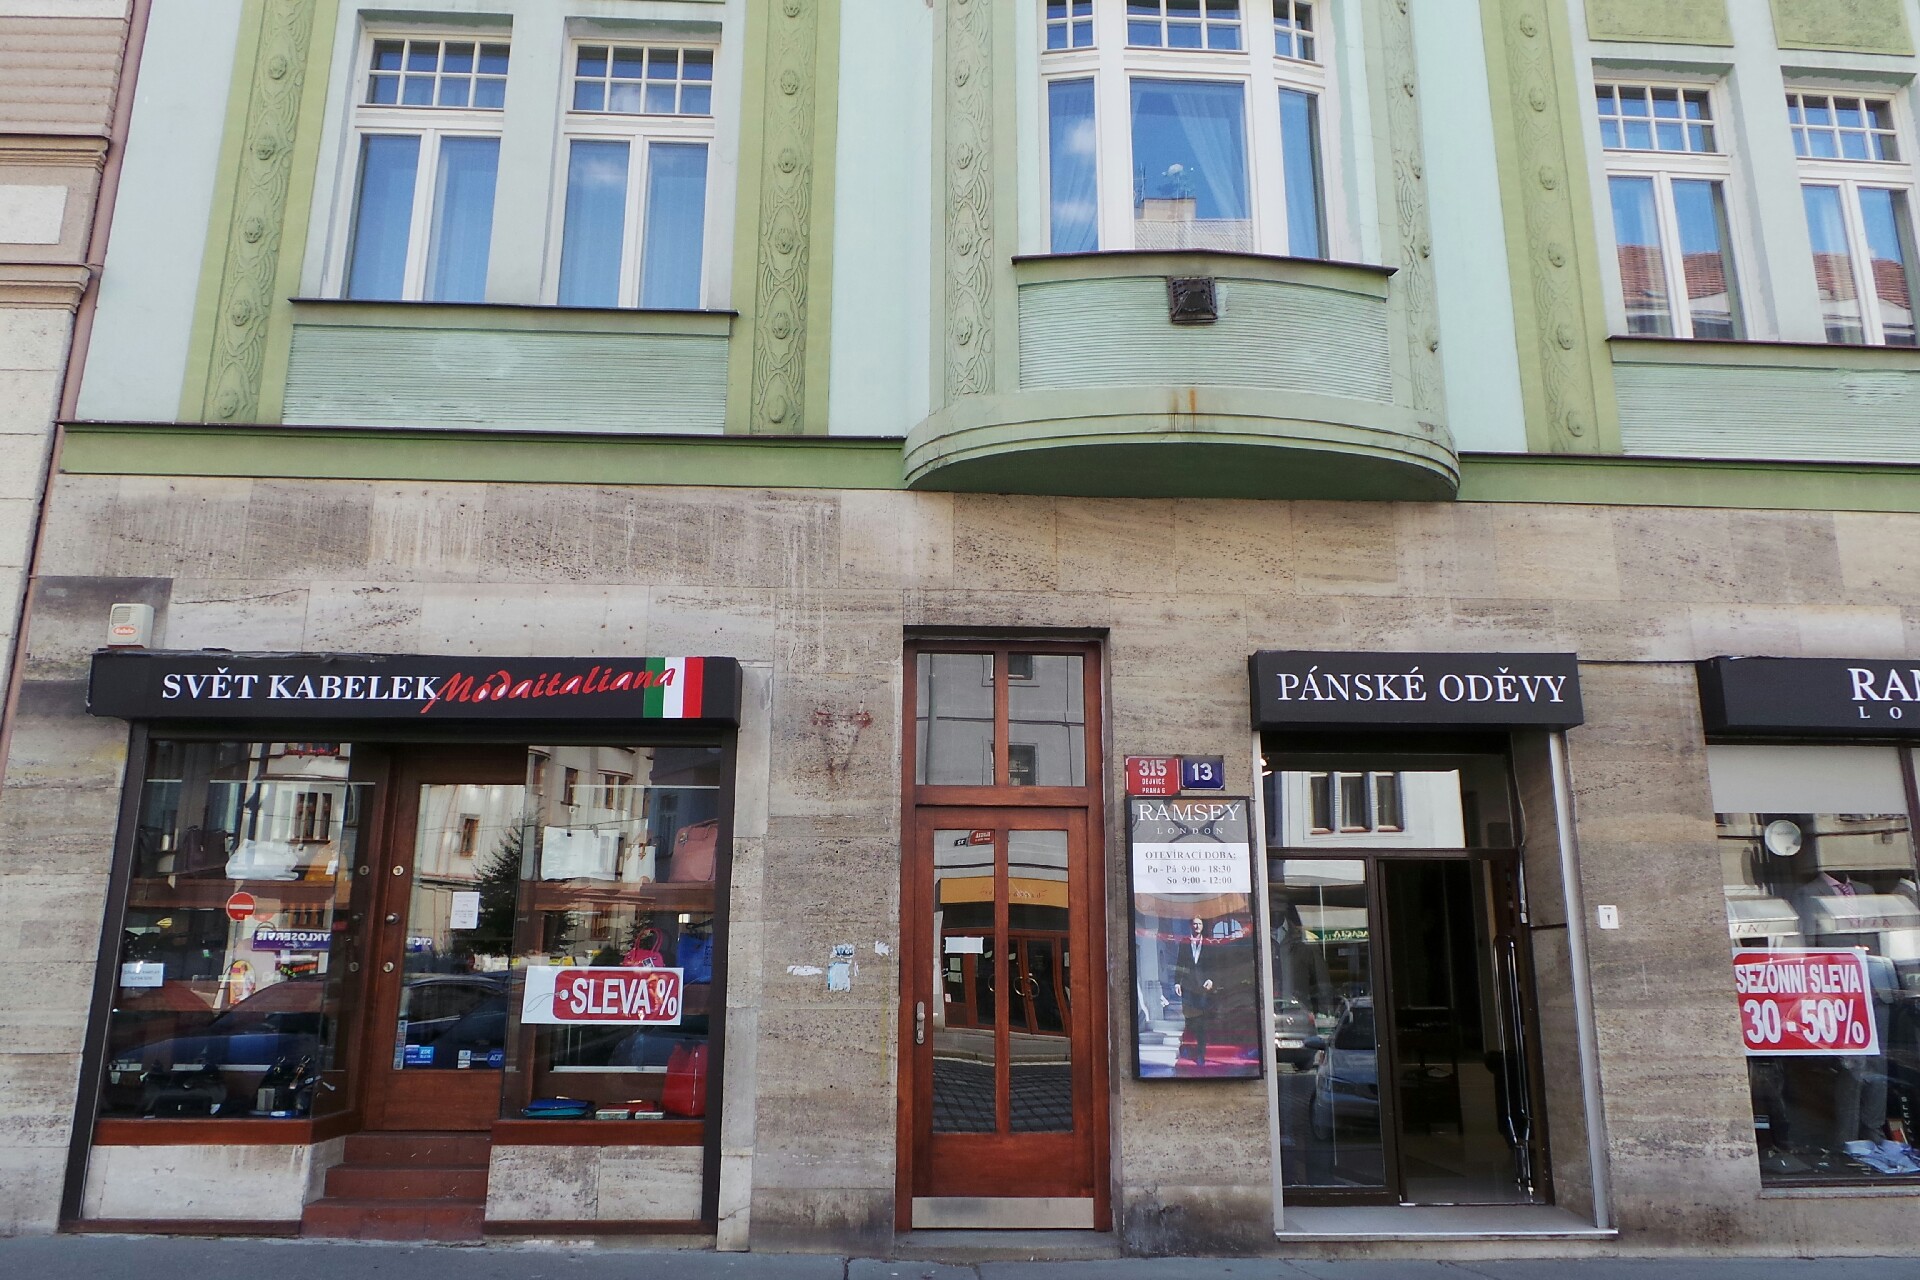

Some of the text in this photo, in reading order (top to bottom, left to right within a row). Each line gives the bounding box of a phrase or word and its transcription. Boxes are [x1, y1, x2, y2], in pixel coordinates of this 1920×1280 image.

[162, 666, 258, 699] SVĚT
[266, 675, 440, 700] KABELEK
[1276, 665, 1566, 702] PÁNSKÉ ODĚVY
[1138, 759, 1167, 777] 315
[1192, 762, 1213, 781] 13
[1138, 803, 1240, 821] RAMSEY
[1204, 851, 1236, 859] DOBA:
[1147, 865, 1158, 873] Po
[1181, 865, 1200, 873] 9:00
[1209, 865, 1232, 873] 18:30
[1166, 876, 1177, 884] So
[1182, 876, 1200, 884] 9:00
[1209, 876, 1232, 884] 12:00
[1735, 958, 1862, 994] SEZÓNNÍ SLEVA
[570, 977, 651, 1014] SLEVA
[1743, 999, 1782, 1044] 30
[1801, 999, 1865, 1044] 50%
